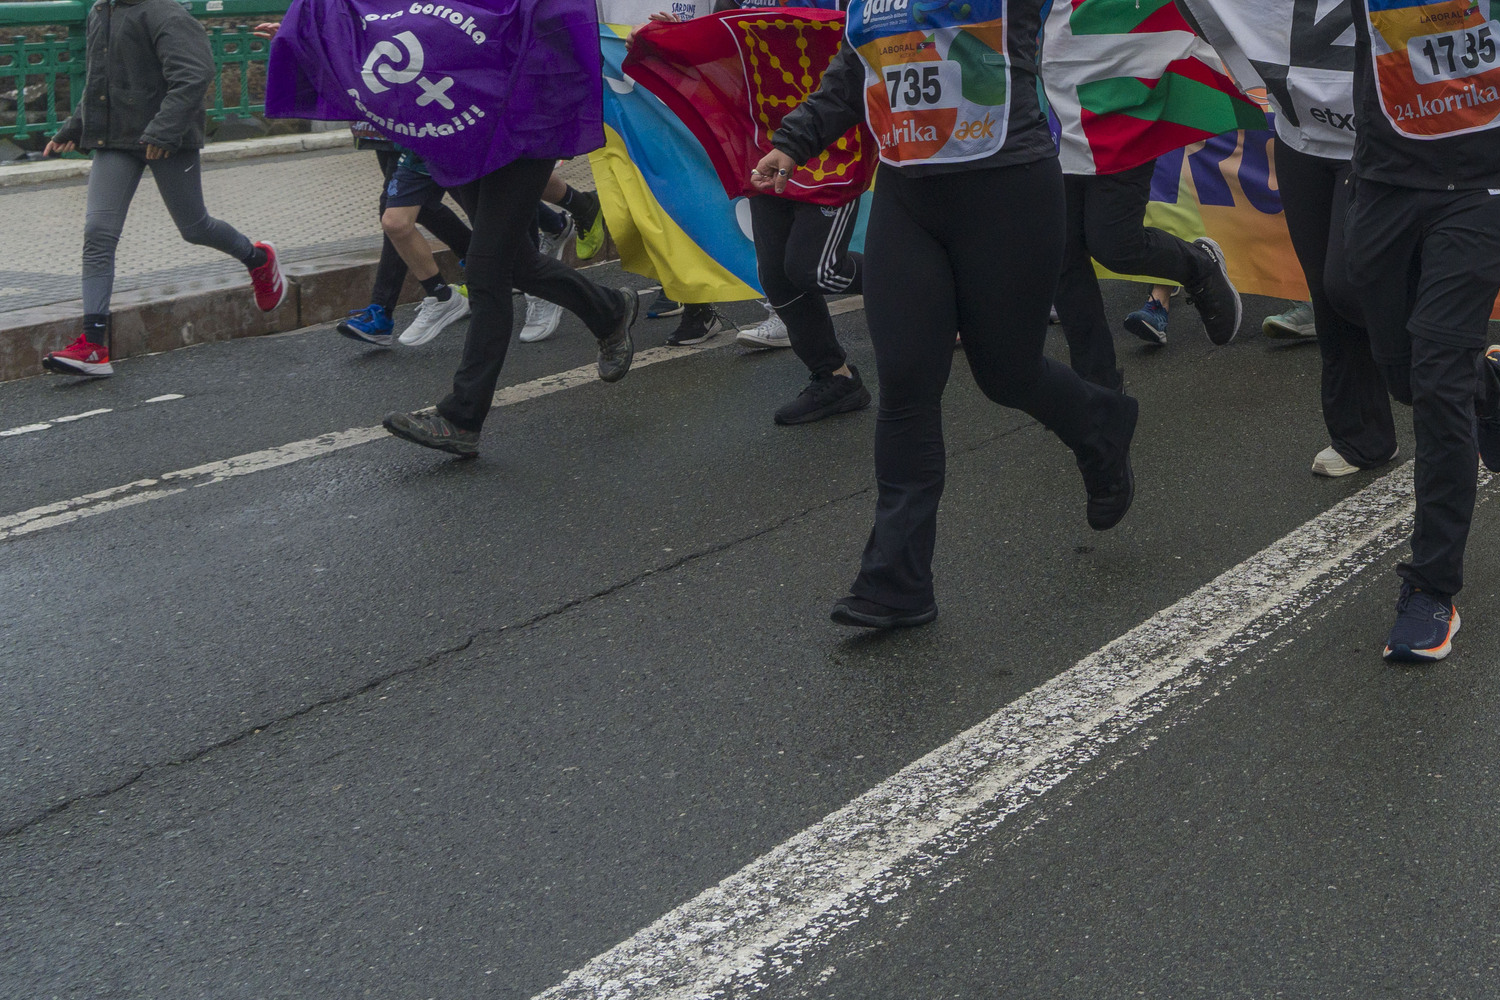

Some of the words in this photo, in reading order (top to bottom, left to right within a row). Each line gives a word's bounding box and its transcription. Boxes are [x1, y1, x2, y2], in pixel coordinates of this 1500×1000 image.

[409, 2, 487, 45] borroka
[1420, 12, 1462, 24] LABORAL
[1423, 27, 1496, 76] 1735
[886, 66, 942, 109] 735
[1394, 83, 1500, 122] 24.korrika
[954, 112, 996, 141] aek
[1310, 107, 1356, 132] etx
